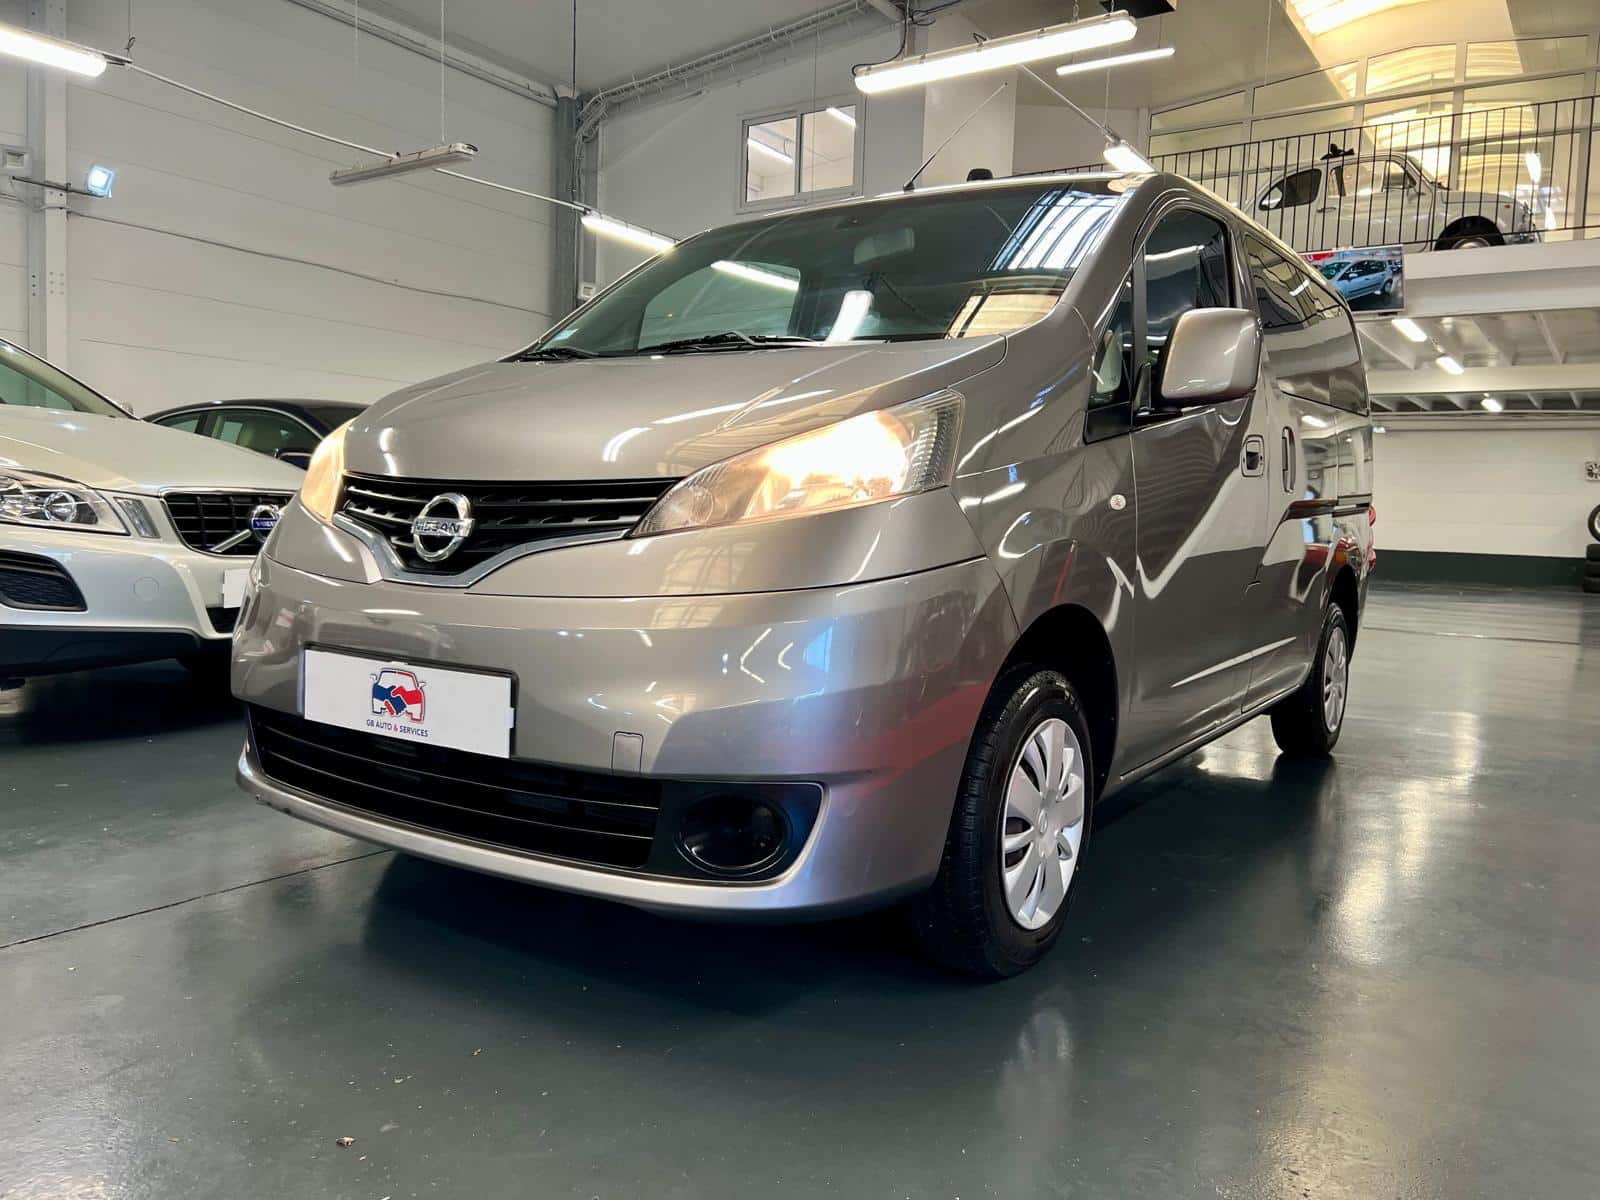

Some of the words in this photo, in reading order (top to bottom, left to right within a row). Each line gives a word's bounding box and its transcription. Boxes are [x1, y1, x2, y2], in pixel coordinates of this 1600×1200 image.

[415, 520, 460, 534] NISSAN
[375, 720, 392, 730] AUTO
[393, 723, 399, 732] &
[399, 725, 429, 737] SERVICES
